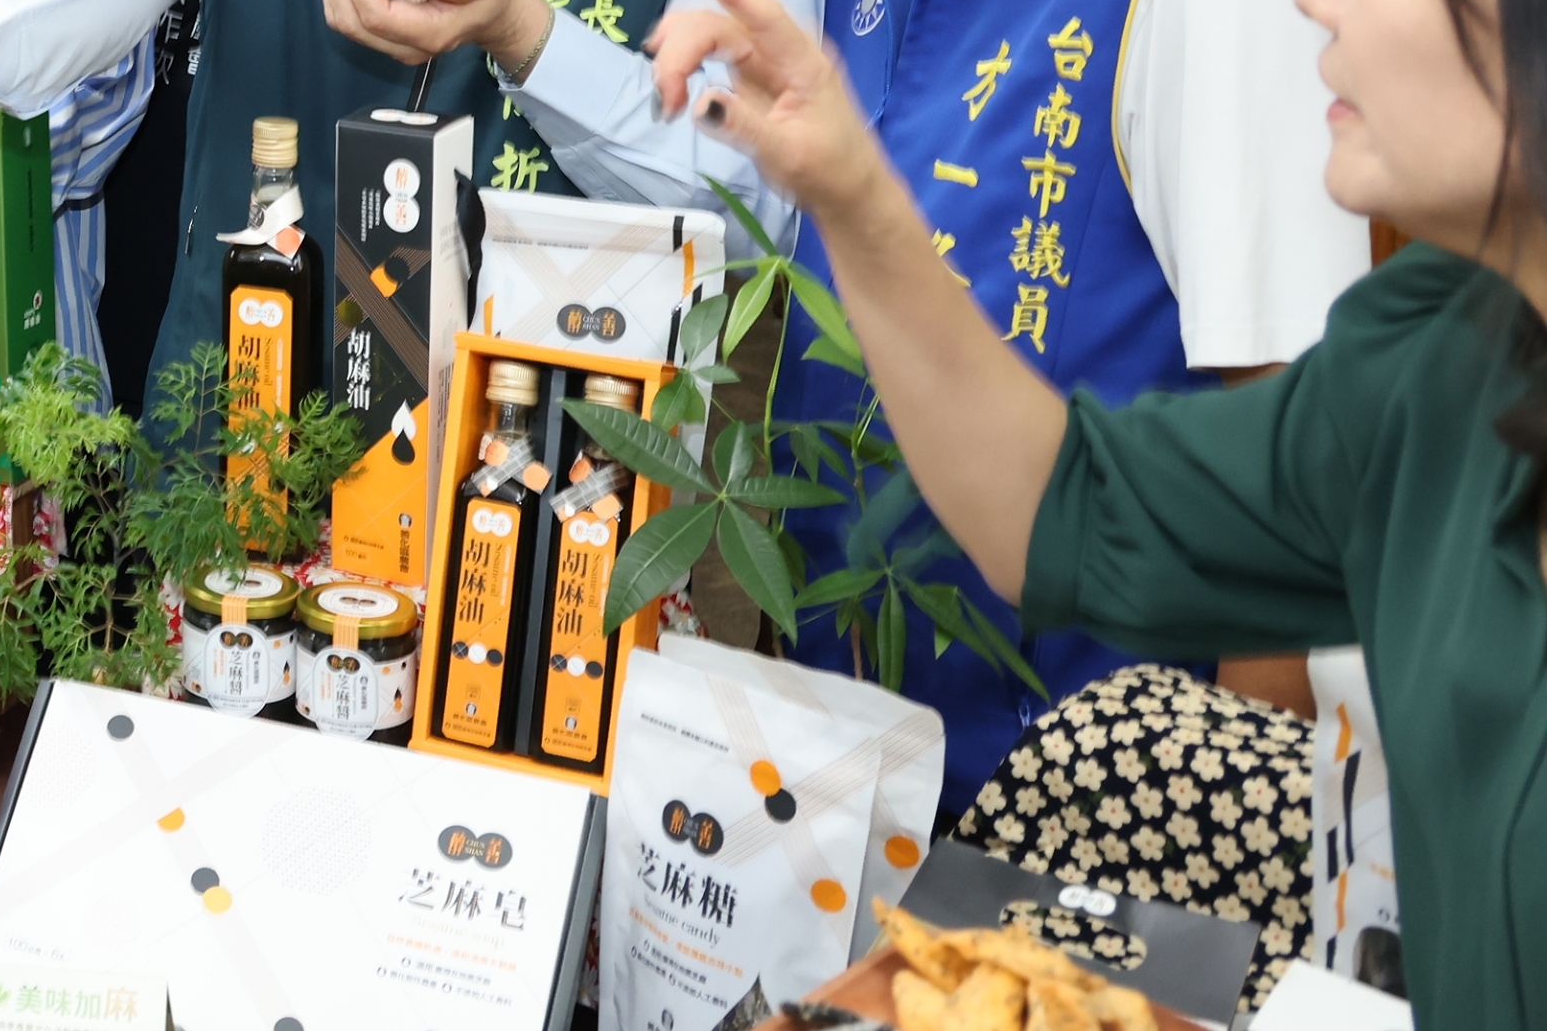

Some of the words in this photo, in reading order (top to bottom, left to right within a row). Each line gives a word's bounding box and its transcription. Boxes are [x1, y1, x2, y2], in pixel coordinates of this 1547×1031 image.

[1001, 15, 1094, 354] 台南市議員
[237, 333, 261, 411] 胡麻油
[346, 327, 372, 411] 胡麻油
[458, 537, 491, 626] 胡麻油
[555, 548, 590, 637] 胡麻油
[464, 846, 484, 857] SHAN
[466, 838, 487, 850] CHUN
[398, 867, 527, 932] 芝麻皂
[636, 840, 739, 928] 芝麻糖
[681, 920, 721, 950] candy
[16, 984, 139, 1023] 美味加麻
